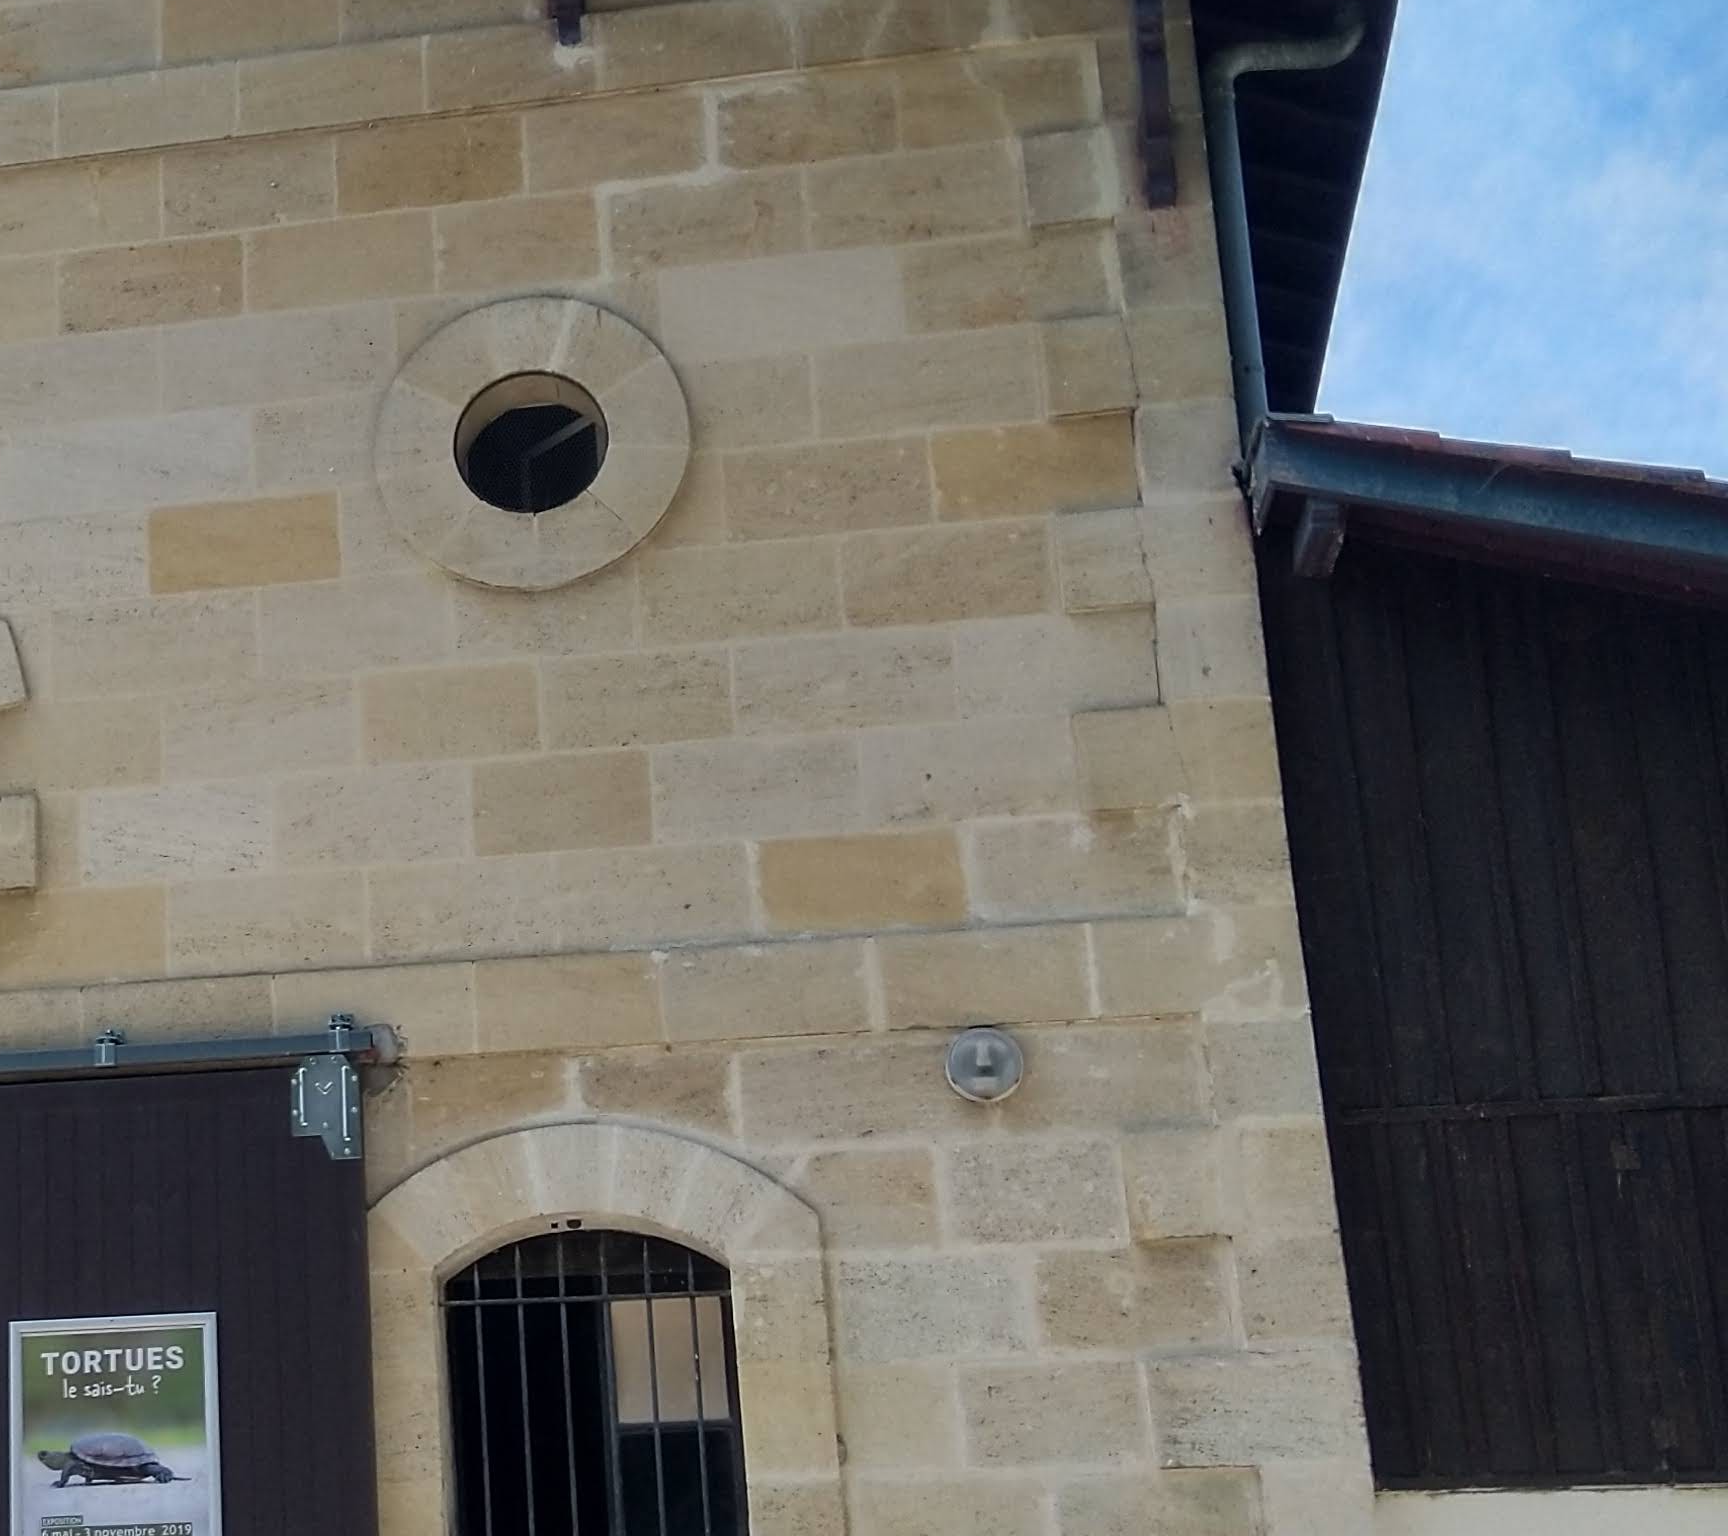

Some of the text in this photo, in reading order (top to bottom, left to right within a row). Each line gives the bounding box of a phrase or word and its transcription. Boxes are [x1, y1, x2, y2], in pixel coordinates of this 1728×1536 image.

[40, 1345, 184, 1376] TORTUES
[62, 1378, 78, 1399] le
[161, 1524, 192, 1536] 2019
